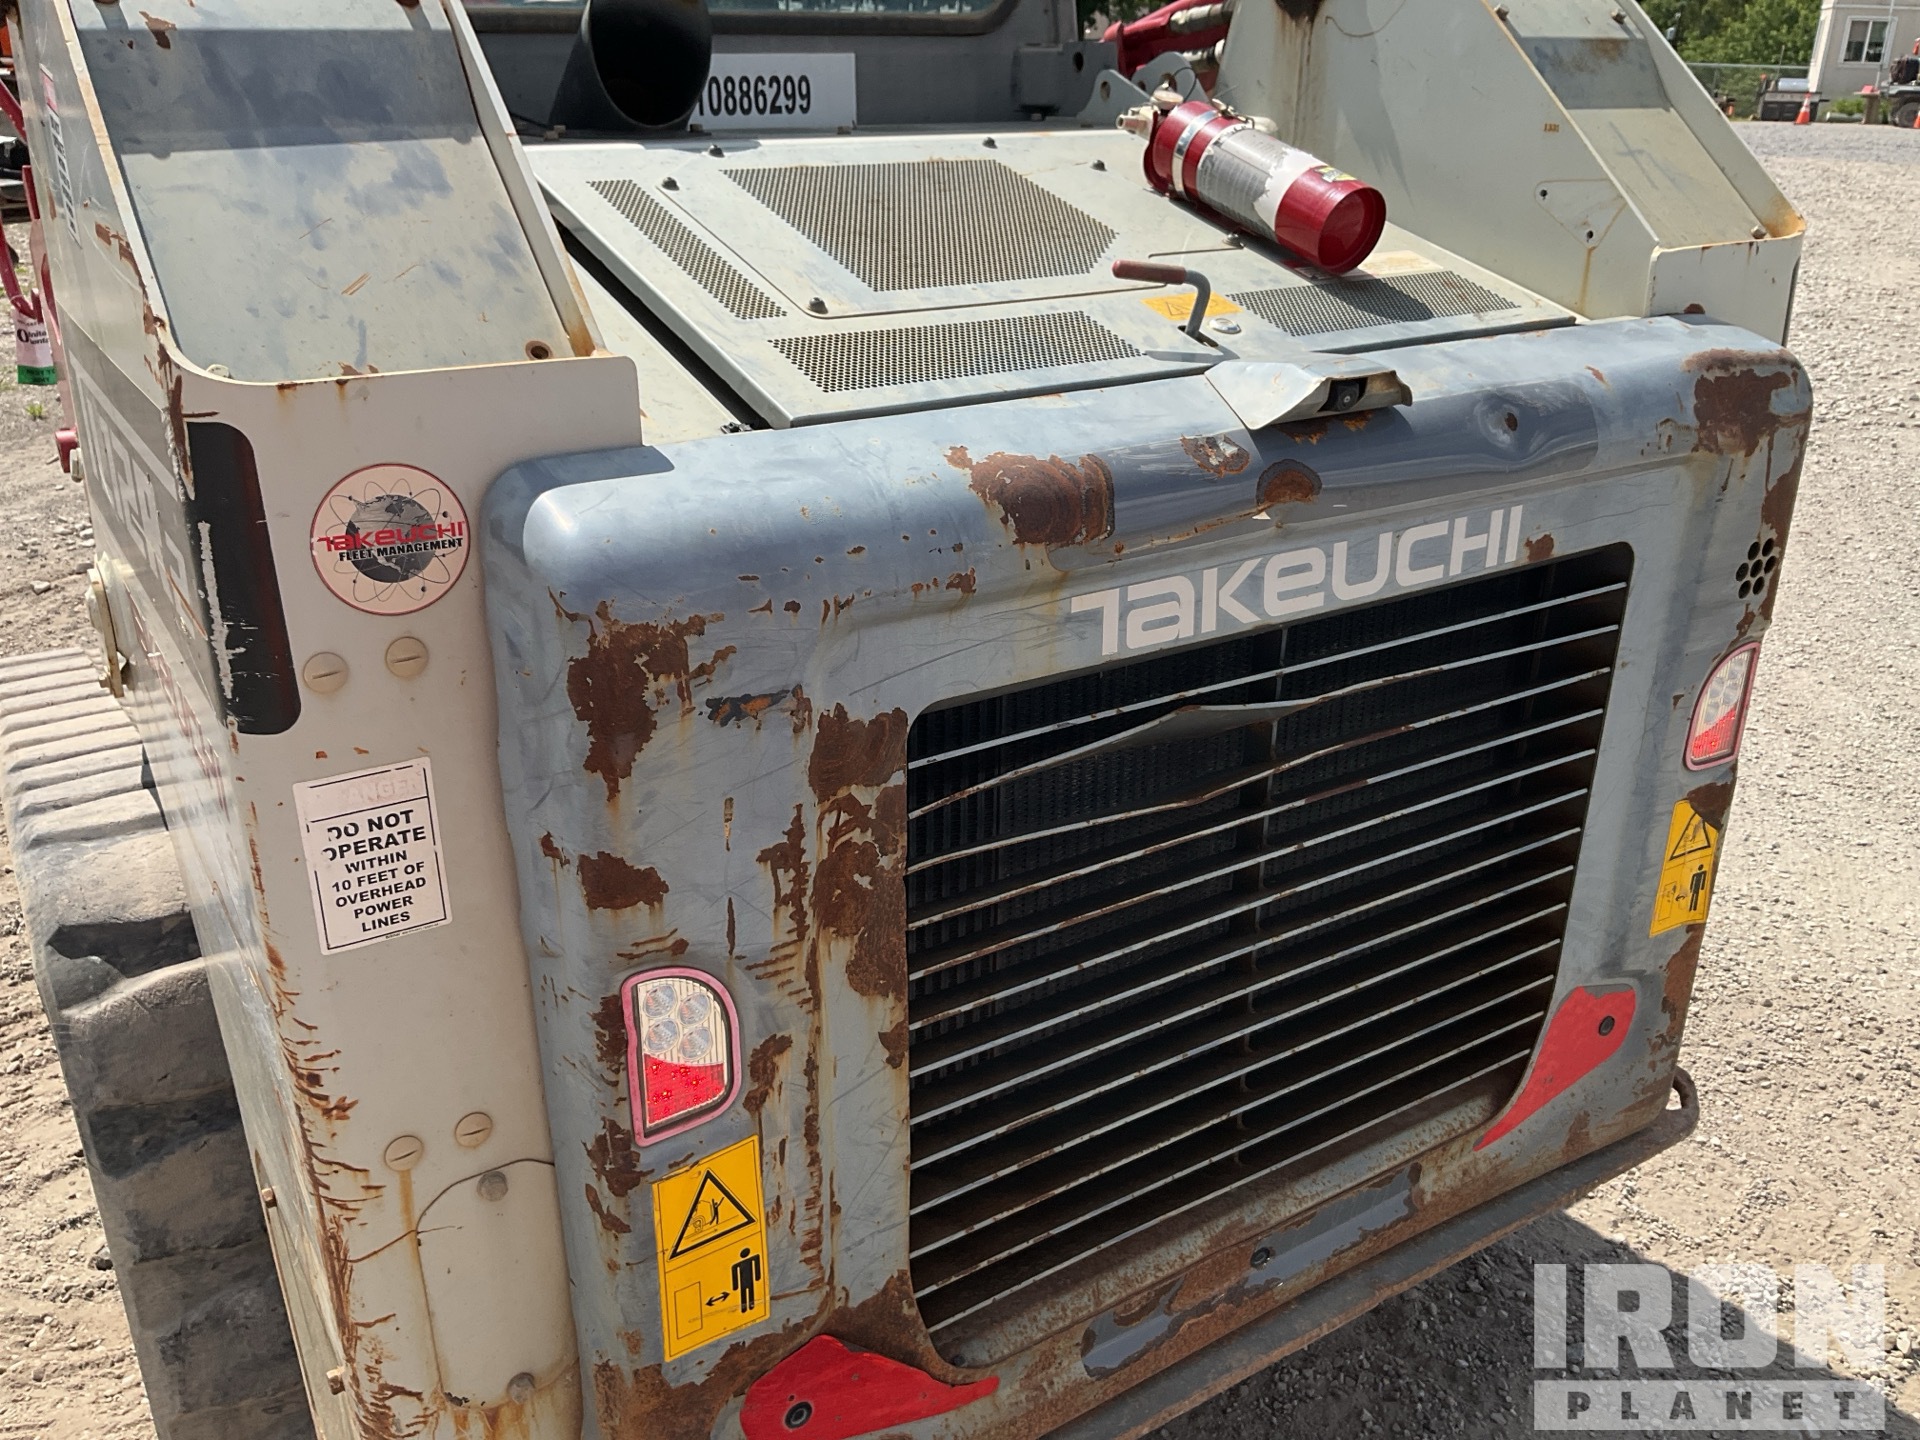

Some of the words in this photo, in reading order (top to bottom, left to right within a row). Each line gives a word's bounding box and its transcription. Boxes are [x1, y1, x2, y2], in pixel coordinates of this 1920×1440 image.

[339, 548, 373, 562] FLEET
[377, 538, 463, 557] MANAGEMENT
[327, 822, 359, 842] DO
[367, 809, 414, 832] NOT
[321, 826, 427, 861] OPERATE
[345, 850, 408, 873] WITHIN
[332, 879, 351, 892] 10
[357, 868, 398, 887] FEET
[404, 861, 425, 875] OF
[335, 877, 427, 907] OVERHEAD
[354, 895, 414, 919] POWER
[361, 911, 411, 932] LINES
